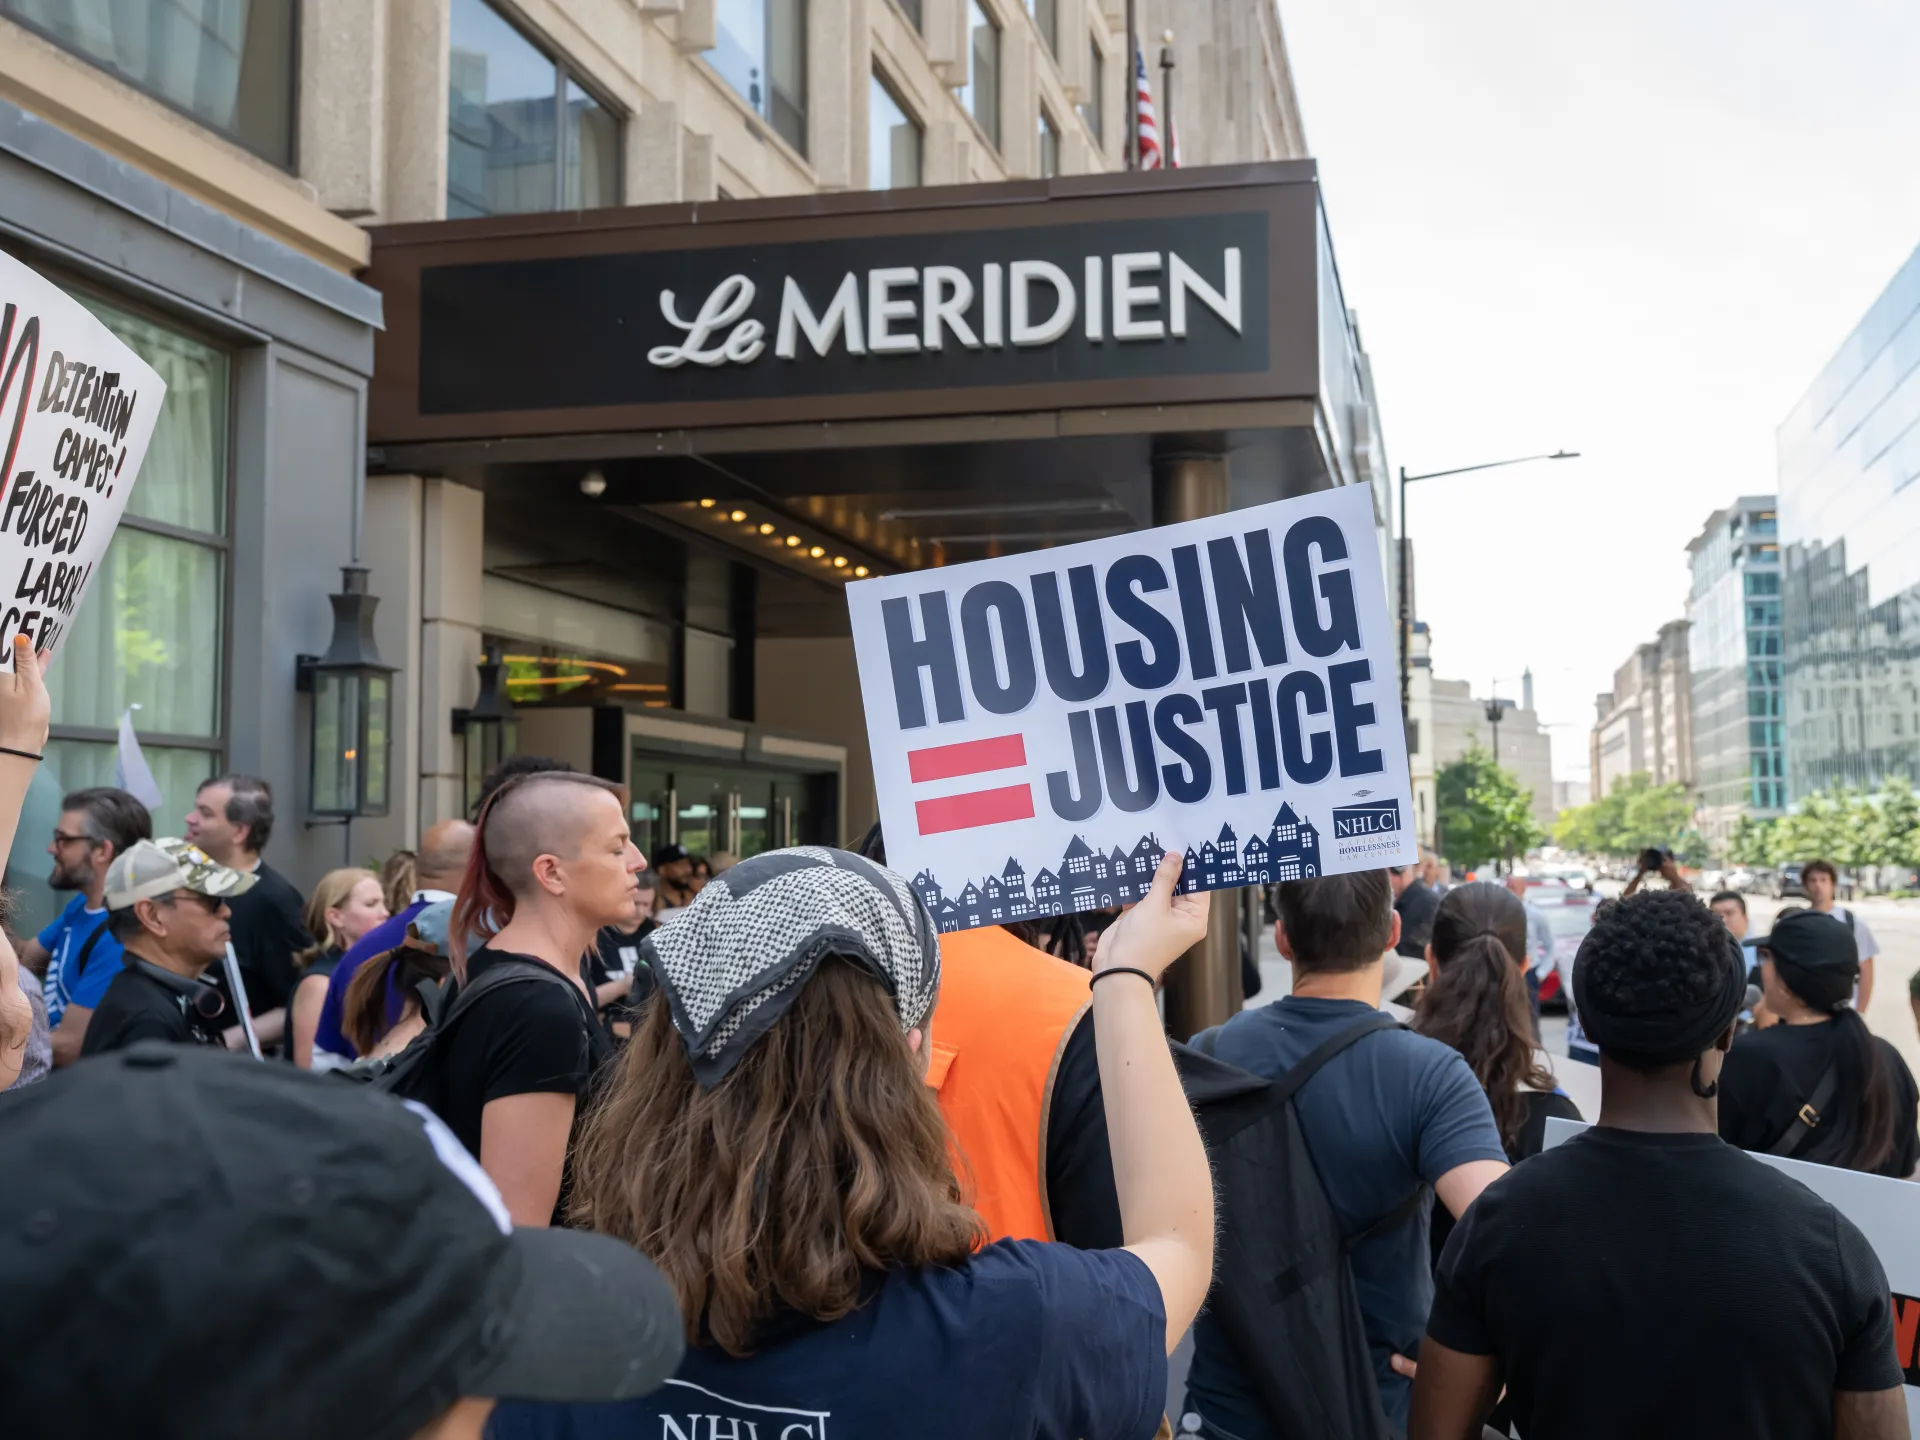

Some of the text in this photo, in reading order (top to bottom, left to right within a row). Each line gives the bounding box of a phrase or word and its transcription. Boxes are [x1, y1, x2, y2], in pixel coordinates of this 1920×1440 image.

[647, 247, 1242, 368] Le MERIDIEN
[37, 350, 137, 447] DETENTION
[53, 427, 127, 499] CAMPS!
[0, 471, 88, 555] FORCED
[881, 516, 1362, 730] HOUSING
[1046, 659, 1385, 823] JUSTICE
[1336, 812, 1394, 836] NHLC
[1338, 833, 1401, 847] NATIONAL
[1339, 840, 1400, 855] HOMELESSNESS
